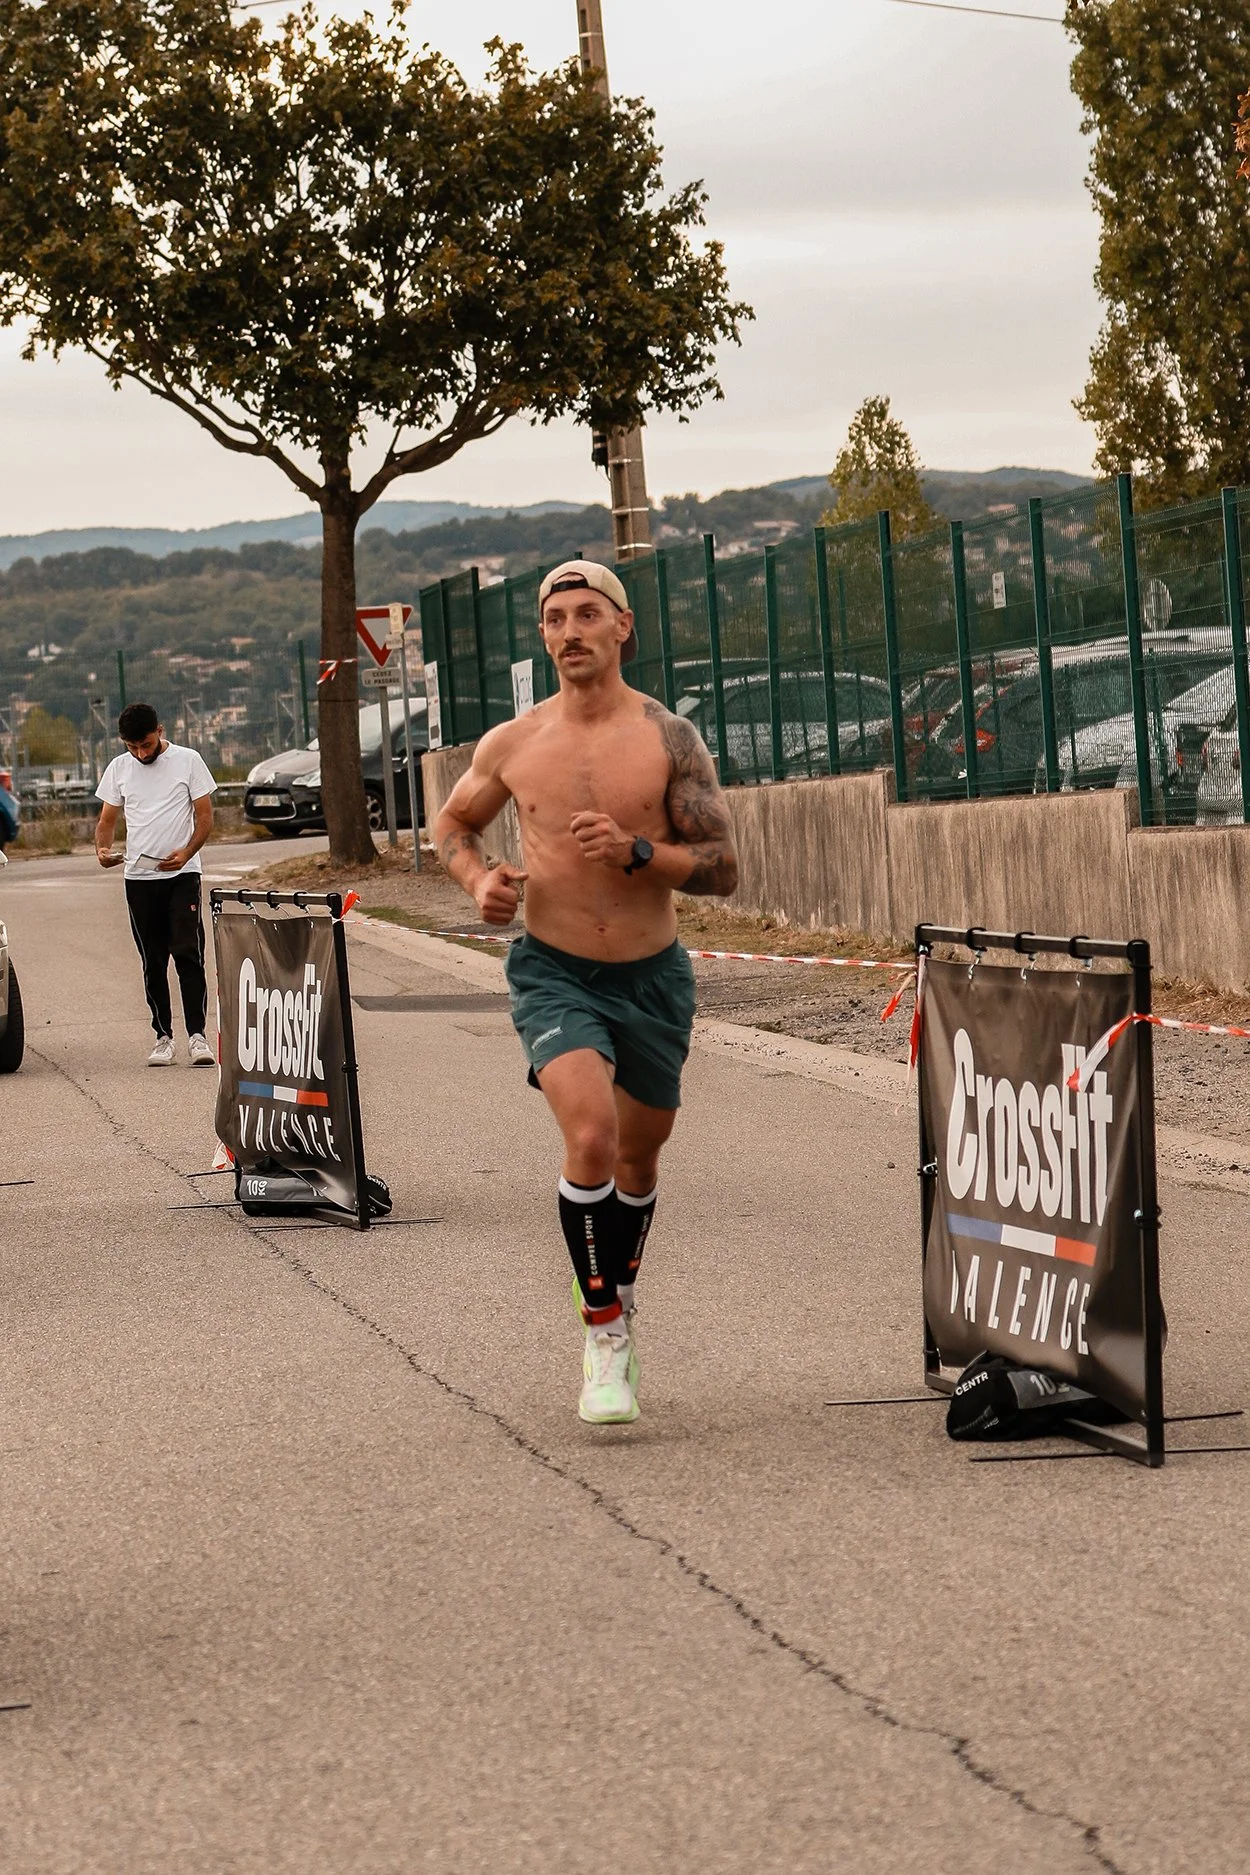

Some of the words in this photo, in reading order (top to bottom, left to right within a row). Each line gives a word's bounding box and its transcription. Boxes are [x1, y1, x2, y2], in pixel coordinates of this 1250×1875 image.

[237, 957, 325, 1081] CrossFit
[238, 1104, 342, 1163] VALENCE
[946, 1028, 1114, 1228] CrossFit
[247, 1179, 257, 1196] 10
[955, 1371, 989, 1396] CENTR
[1030, 1374, 1057, 1396] 10
